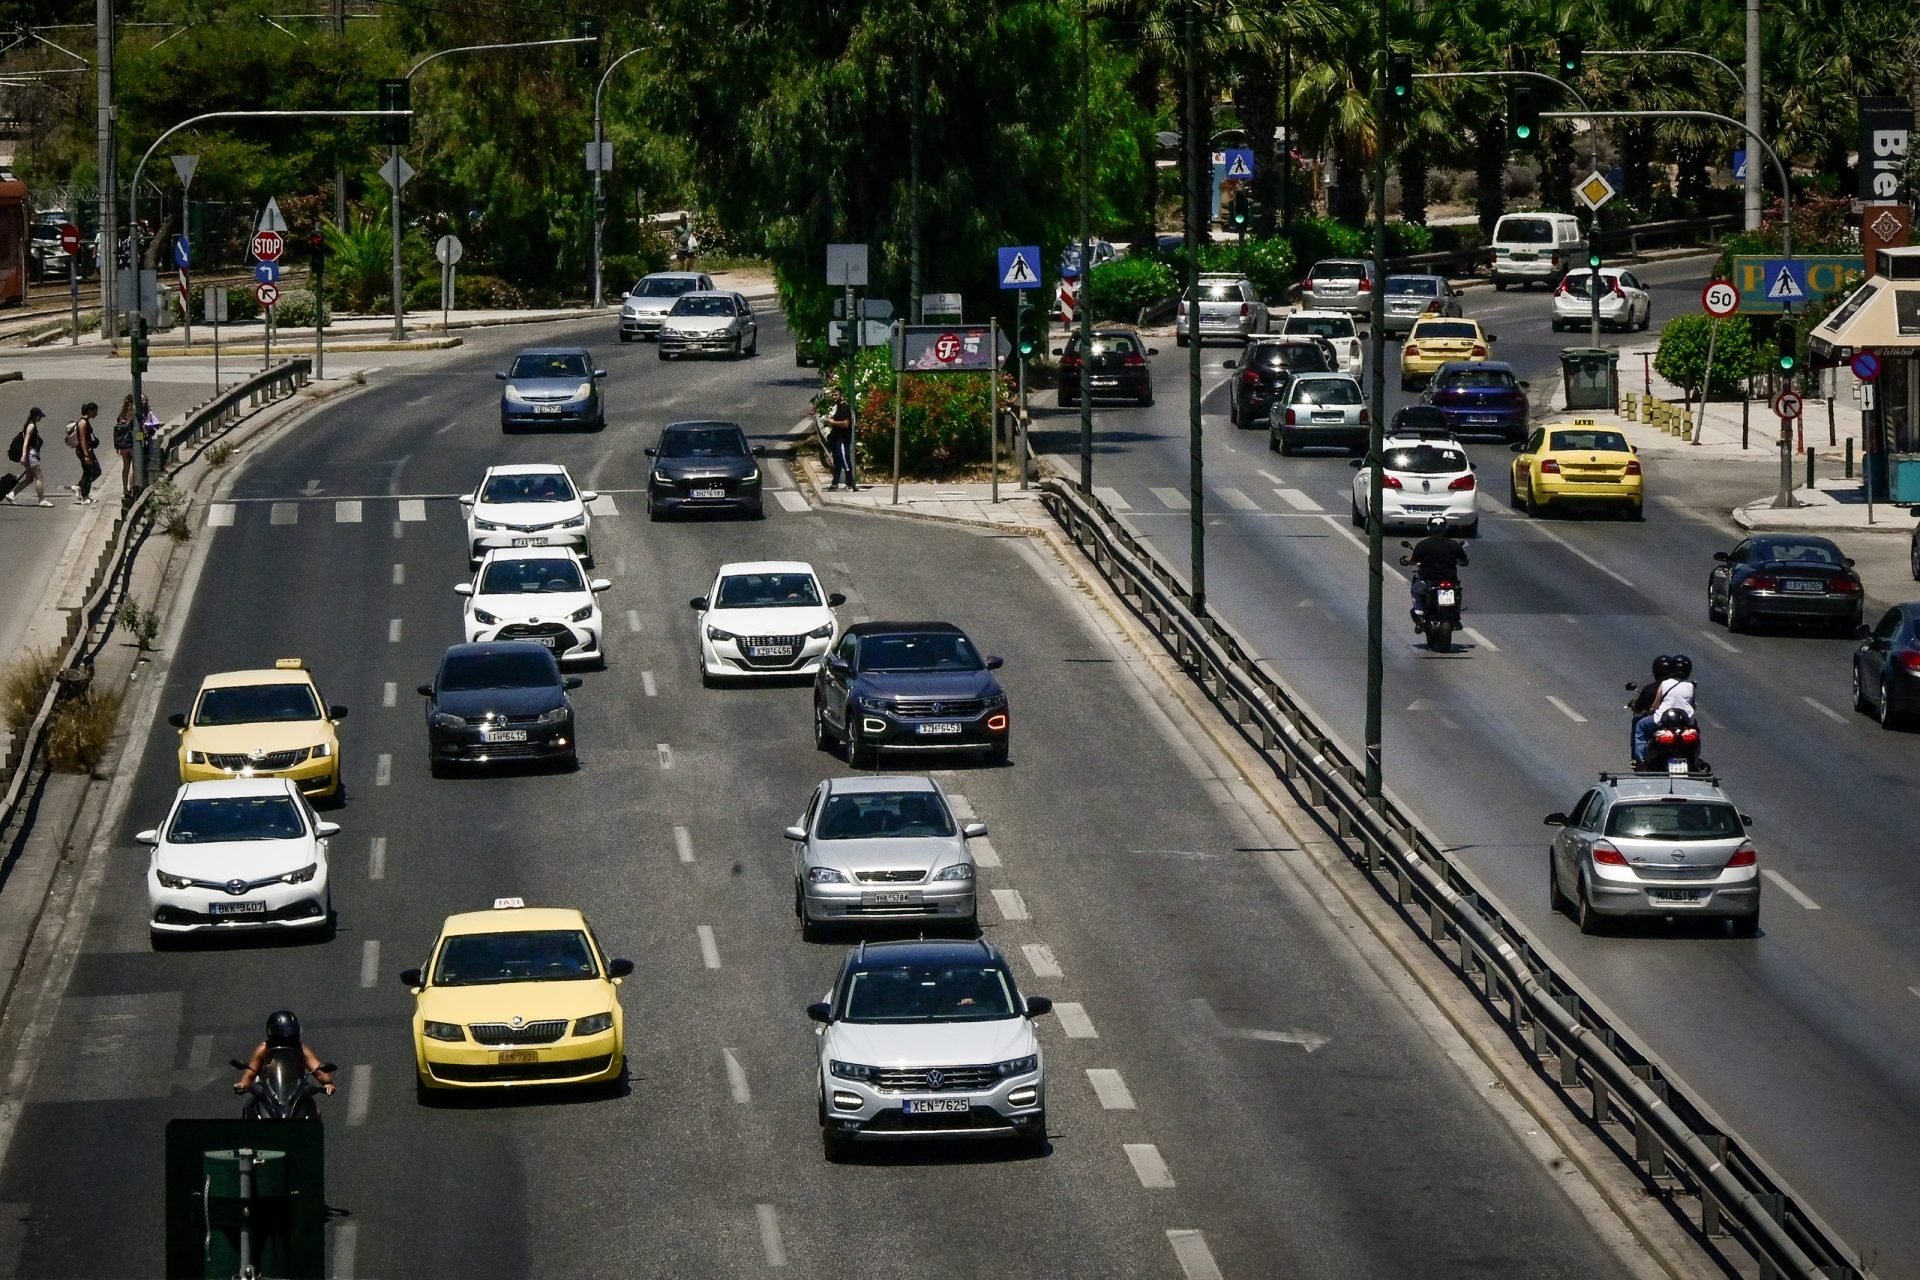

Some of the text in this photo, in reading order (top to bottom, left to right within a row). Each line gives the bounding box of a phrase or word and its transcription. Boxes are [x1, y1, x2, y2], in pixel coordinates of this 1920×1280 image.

[254, 238, 280, 254] STOP
[1709, 291, 1732, 306] 50
[913, 1100, 968, 1112] XEN-7625
